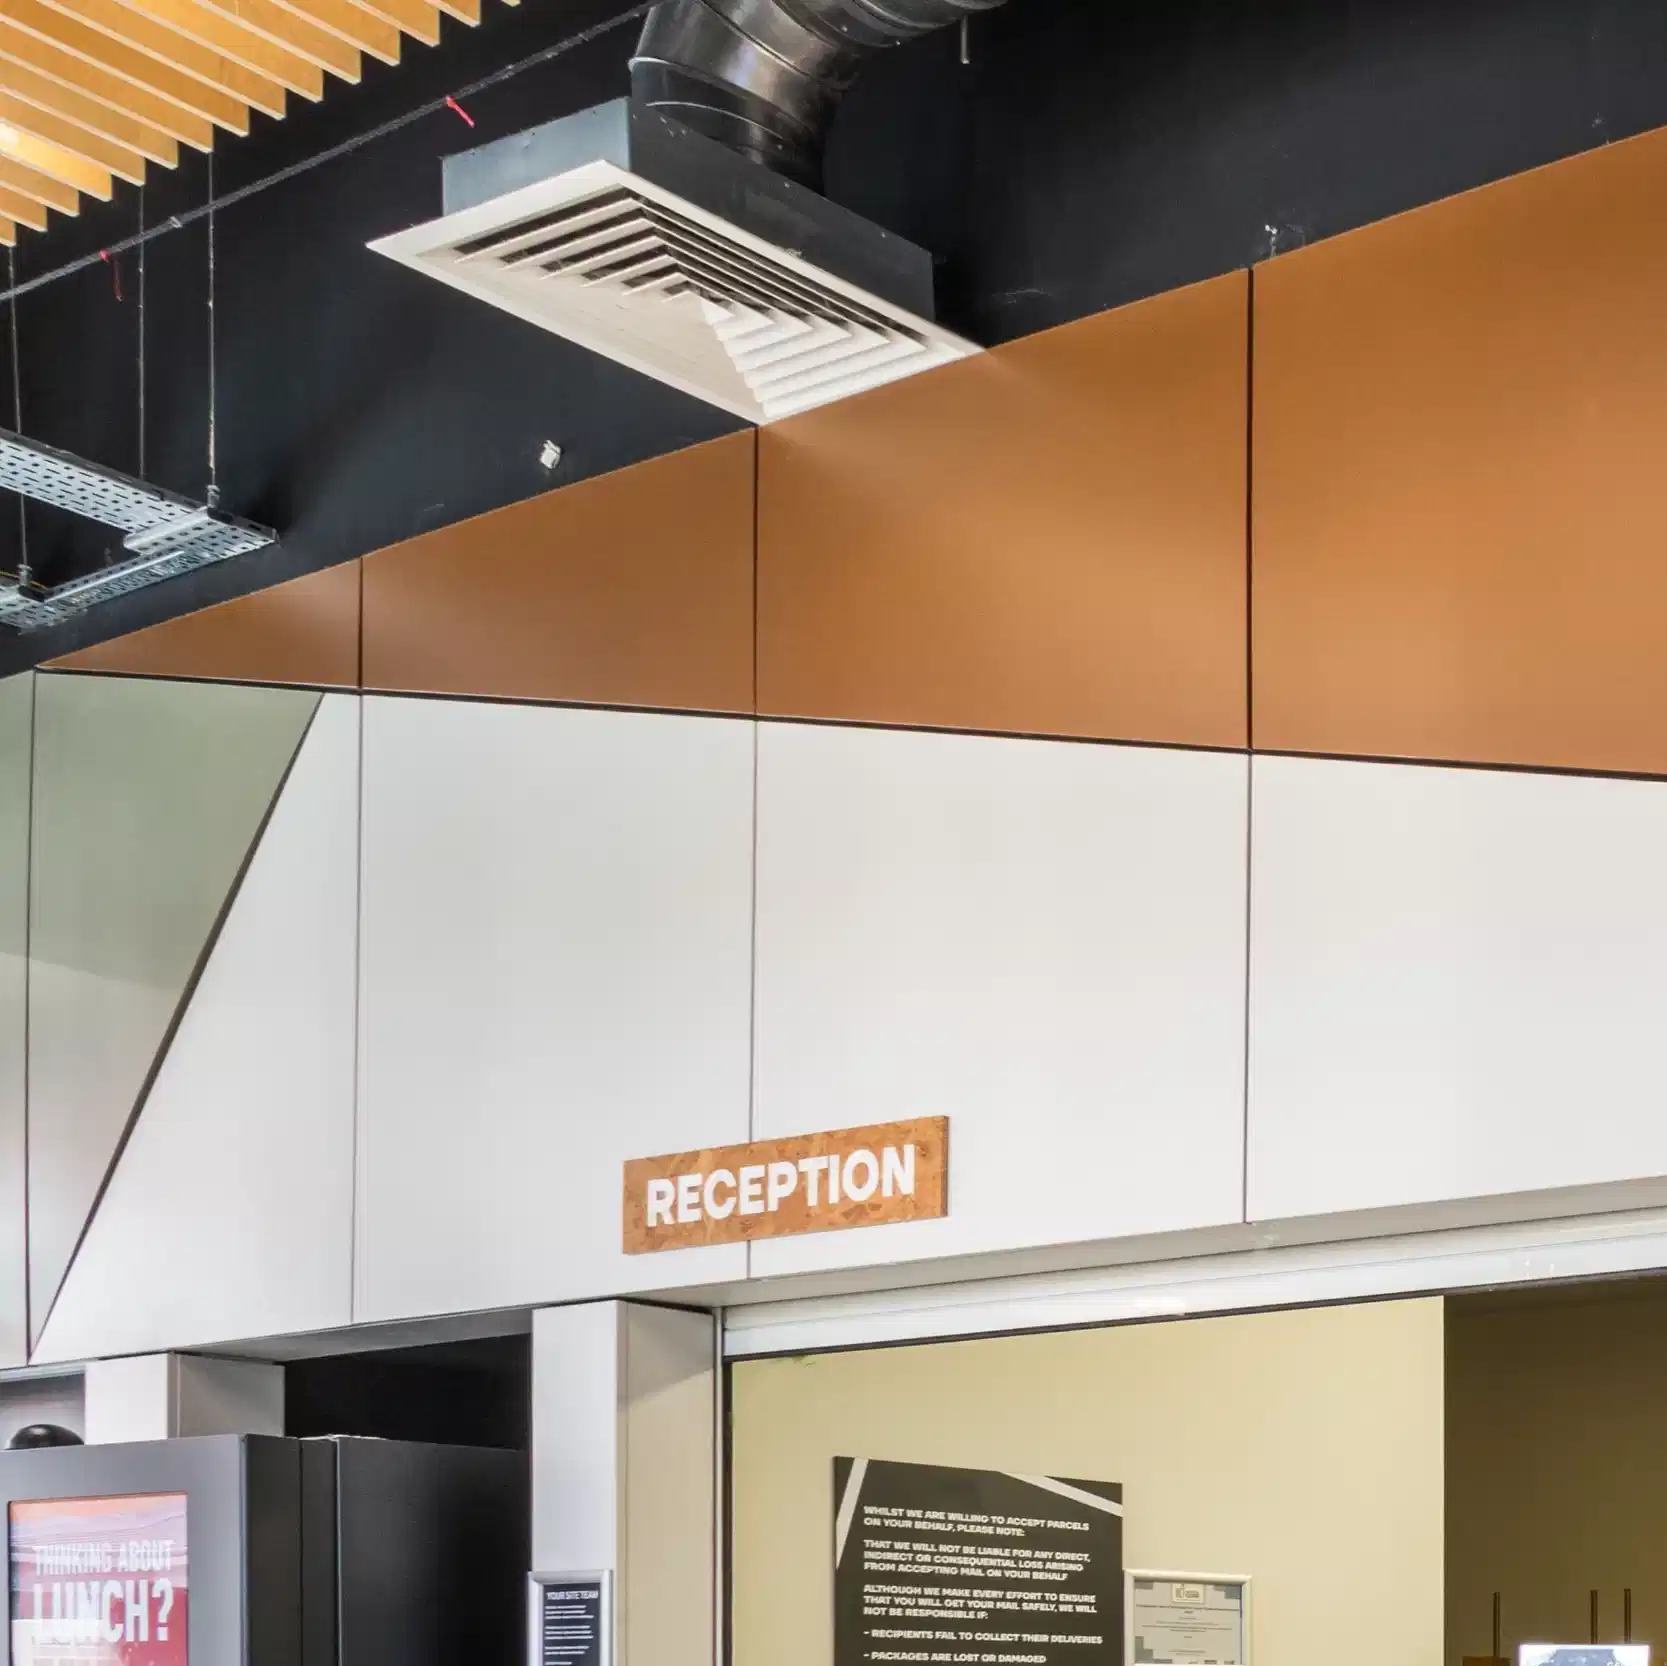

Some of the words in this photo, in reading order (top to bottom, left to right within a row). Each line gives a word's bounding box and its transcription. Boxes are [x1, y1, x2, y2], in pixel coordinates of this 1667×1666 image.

[647, 1143, 915, 1228] RECEPTION
[864, 1506, 904, 1517] WHILST
[906, 1509, 922, 1518] WE
[924, 1511, 945, 1520] ARE
[947, 1512, 988, 1523] WILLING
[990, 1515, 1005, 1524] TO
[1006, 1517, 1045, 1527] ACCEPT
[1047, 1520, 1089, 1531] PARCELS
[864, 1517, 880, 1526] ON
[883, 1519, 912, 1528] YOUR
[914, 1521, 955, 1531] BEHALF,
[956, 1524, 994, 1534] PLEASE
[996, 1527, 1025, 1536] NOTE:
[32, 1542, 112, 1576] THINKING
[118, 1539, 174, 1572] ABOUT
[864, 1540, 891, 1550] THAT
[893, 1541, 910, 1551] WE
[912, 1542, 937, 1552] WILL
[938, 1544, 960, 1554] NOT
[962, 1546, 975, 1555] BE
[977, 1547, 1010, 1557] LIABLE
[1012, 1549, 1032, 1558] FOR
[1033, 1550, 1053, 1559] ANY
[1055, 1551, 1091, 1562] DIRECT,
[33, 1578, 173, 1643] LUNCH?
